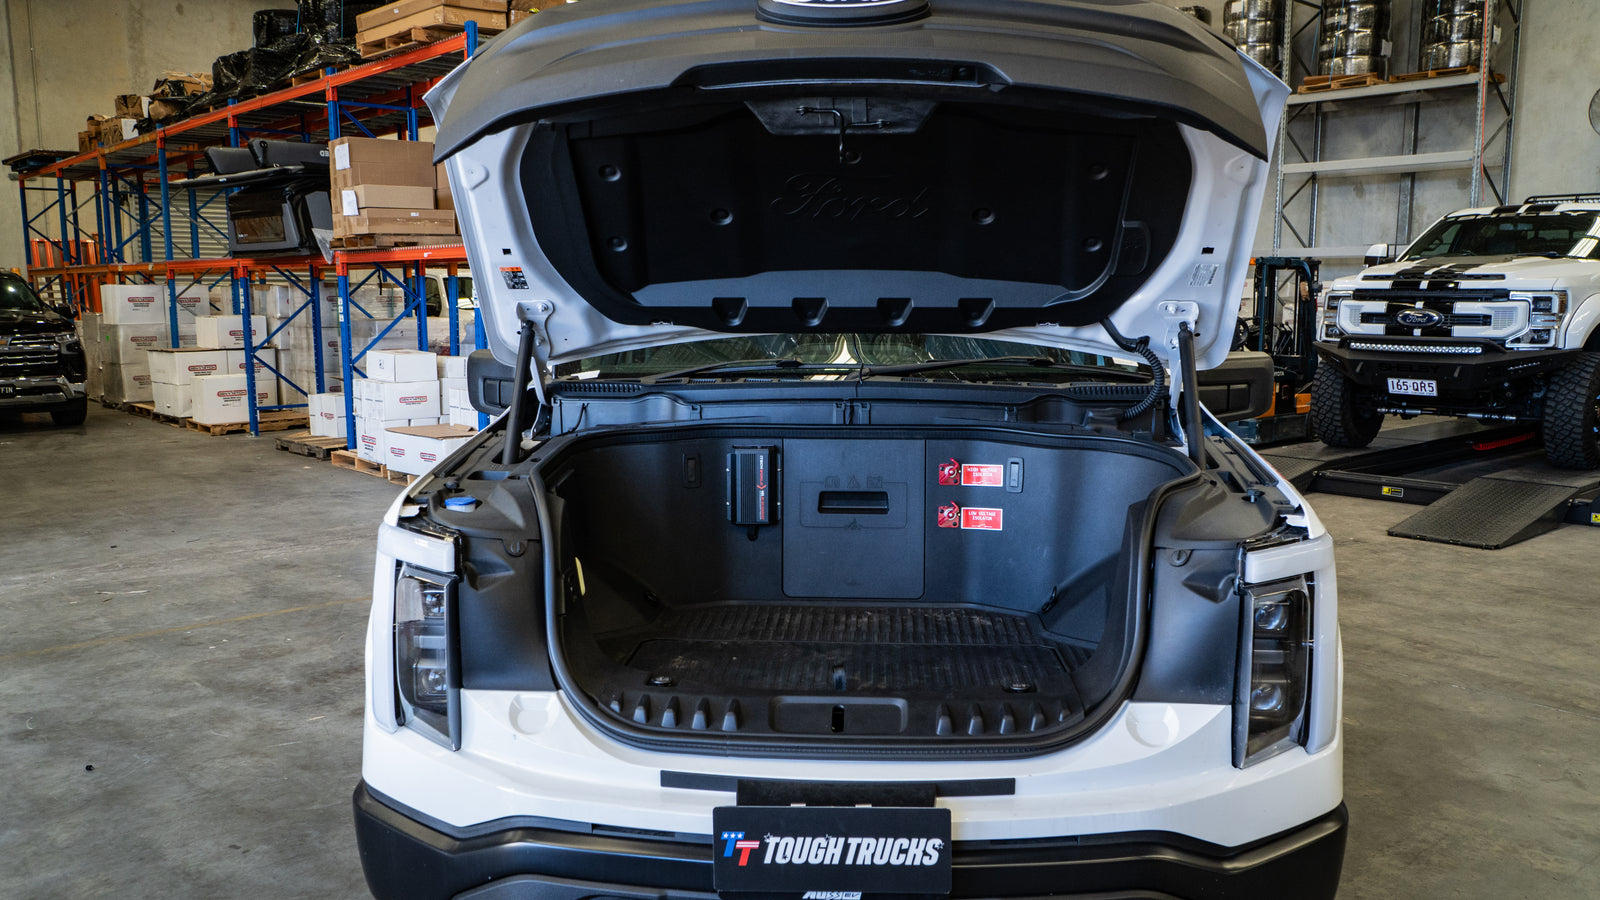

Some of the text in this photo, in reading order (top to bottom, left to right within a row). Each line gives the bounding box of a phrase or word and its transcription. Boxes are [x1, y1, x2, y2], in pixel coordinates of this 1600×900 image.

[1406, 315, 1428, 323] Ford
[763, 834, 942, 866] TOUGH TRUCKS
